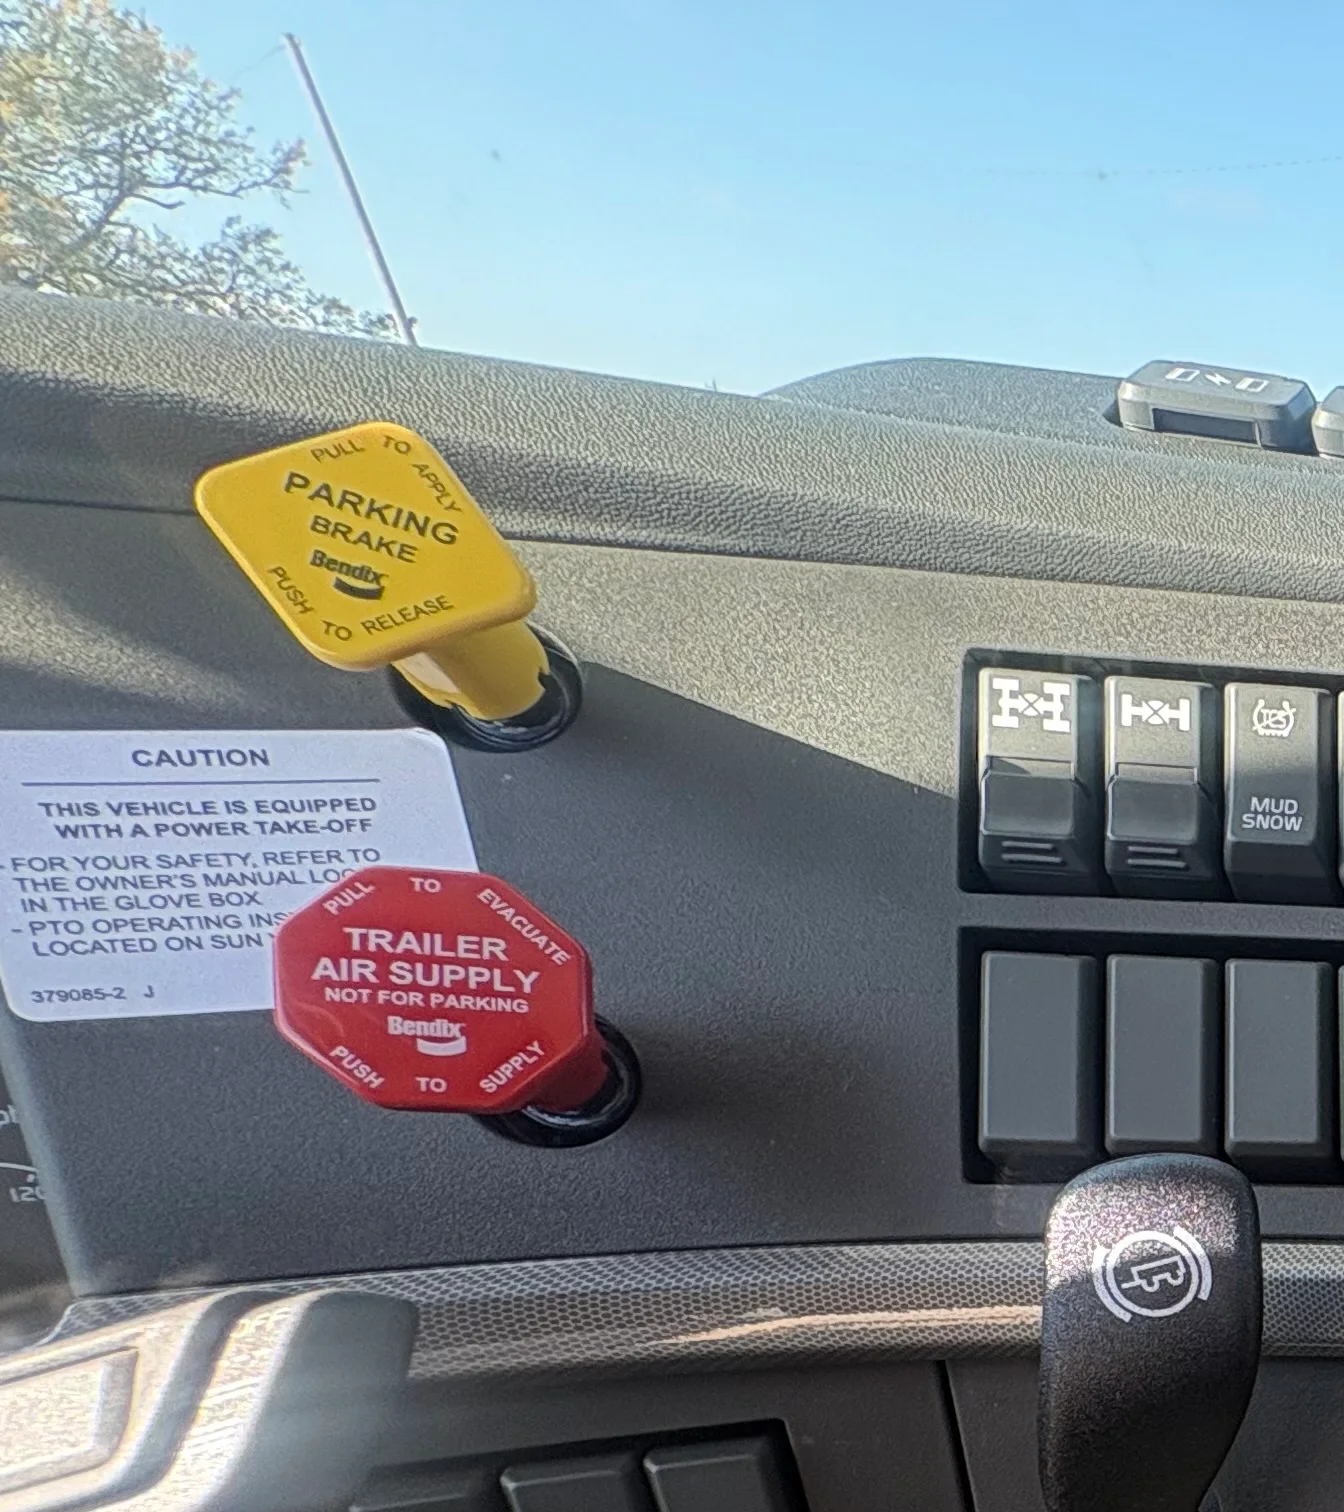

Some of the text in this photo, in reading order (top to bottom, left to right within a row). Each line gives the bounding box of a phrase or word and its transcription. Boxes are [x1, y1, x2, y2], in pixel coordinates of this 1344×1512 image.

[311, 435, 463, 514] PULL TO APPLY
[284, 471, 459, 545] PARKING
[310, 515, 418, 563] BRAKE
[310, 549, 388, 586] Bendix
[270, 566, 454, 641] PUSH TO RELEASE
[132, 749, 270, 768] CAUTION
[38, 798, 376, 817] THIS VEHICLE IS EQUIPPED
[1251, 797, 1298, 814] MUD
[54, 818, 372, 839] WITH A POWER TAKE-OFF
[1242, 814, 1303, 831] SNOW
[11, 856, 70, 872] FOR
[73, 855, 152, 871] YOUR
[263, 850, 344, 866] REFER
[347, 848, 380, 863] TO
[12, 876, 70, 892] THE
[76, 873, 197, 891] OWNER'S
[203, 870, 308, 887] MANUAL
[20, 891, 263, 913] IN THE GLOVE BOX
[29, 912, 294, 936] PTO OPERATING INS
[322, 877, 571, 966] PULL TO EVACUATE
[32, 937, 157, 956] LOCATED
[165, 935, 204, 951] ON
[211, 933, 264, 949] SUN
[343, 927, 509, 962] TRAILER
[311, 957, 541, 994] AIR SUPPLY
[31, 985, 155, 1003] 379085-2 J
[324, 987, 529, 1013] NOT FOR PARKING
[387, 1015, 466, 1038] Bendix
[328, 1040, 546, 1094] PUSH TO SUPPLY
